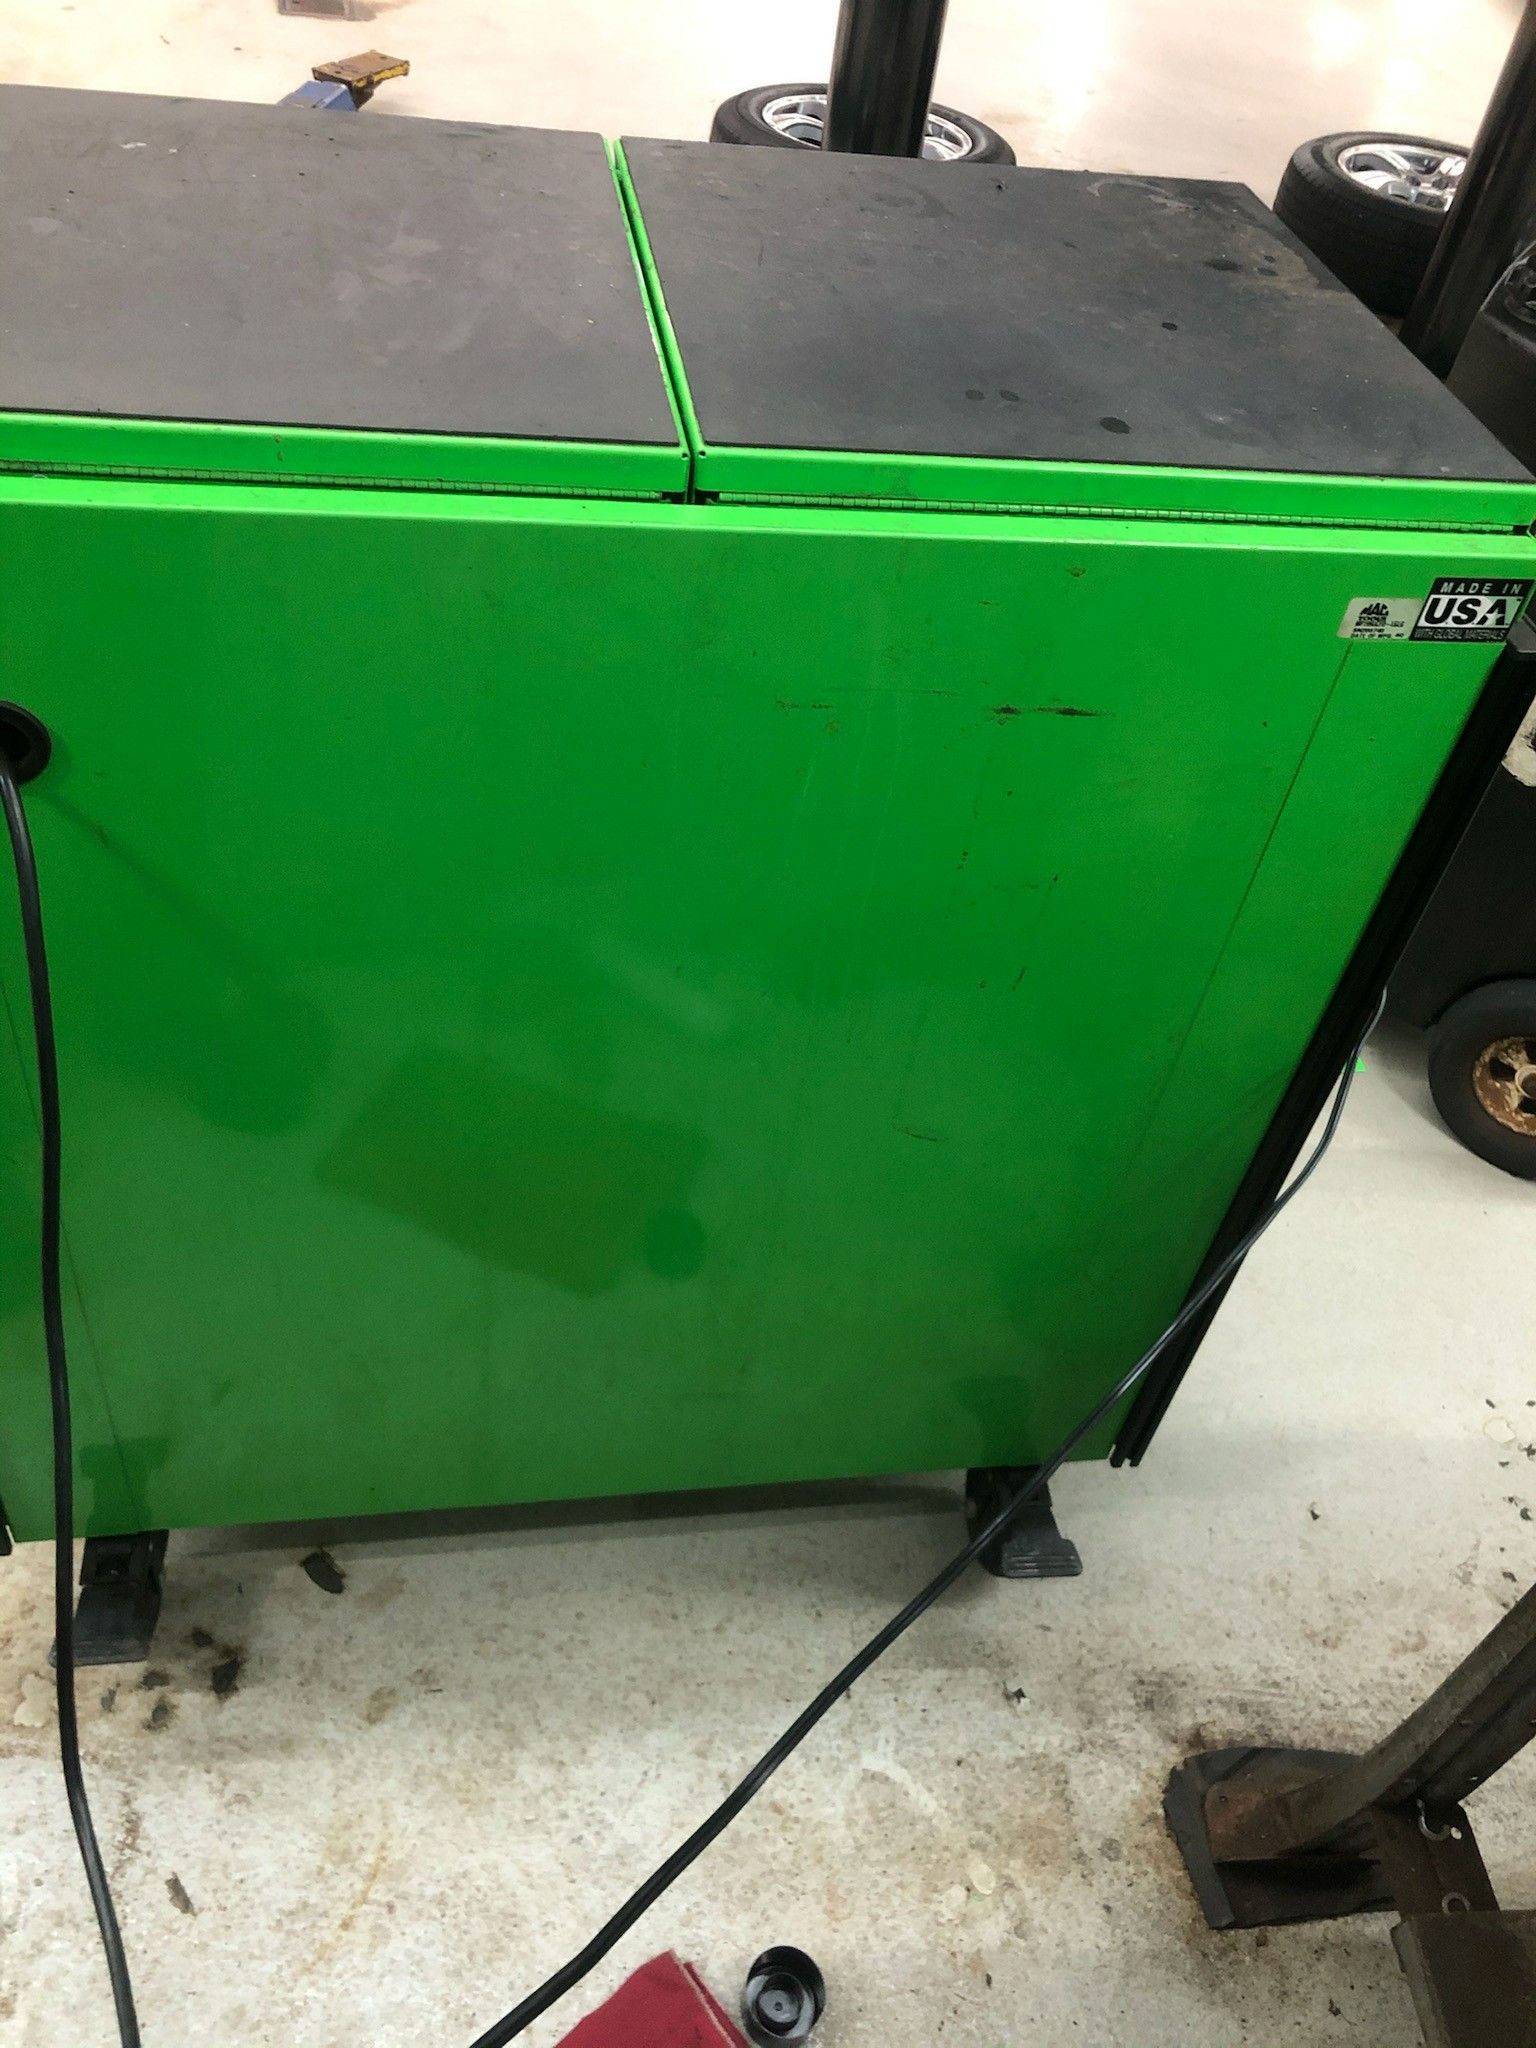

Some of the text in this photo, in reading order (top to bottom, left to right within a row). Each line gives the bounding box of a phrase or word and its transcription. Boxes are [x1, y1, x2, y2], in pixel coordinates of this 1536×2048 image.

[1440, 582, 1522, 594] MADE IN
[1360, 603, 1389, 615] MAC
